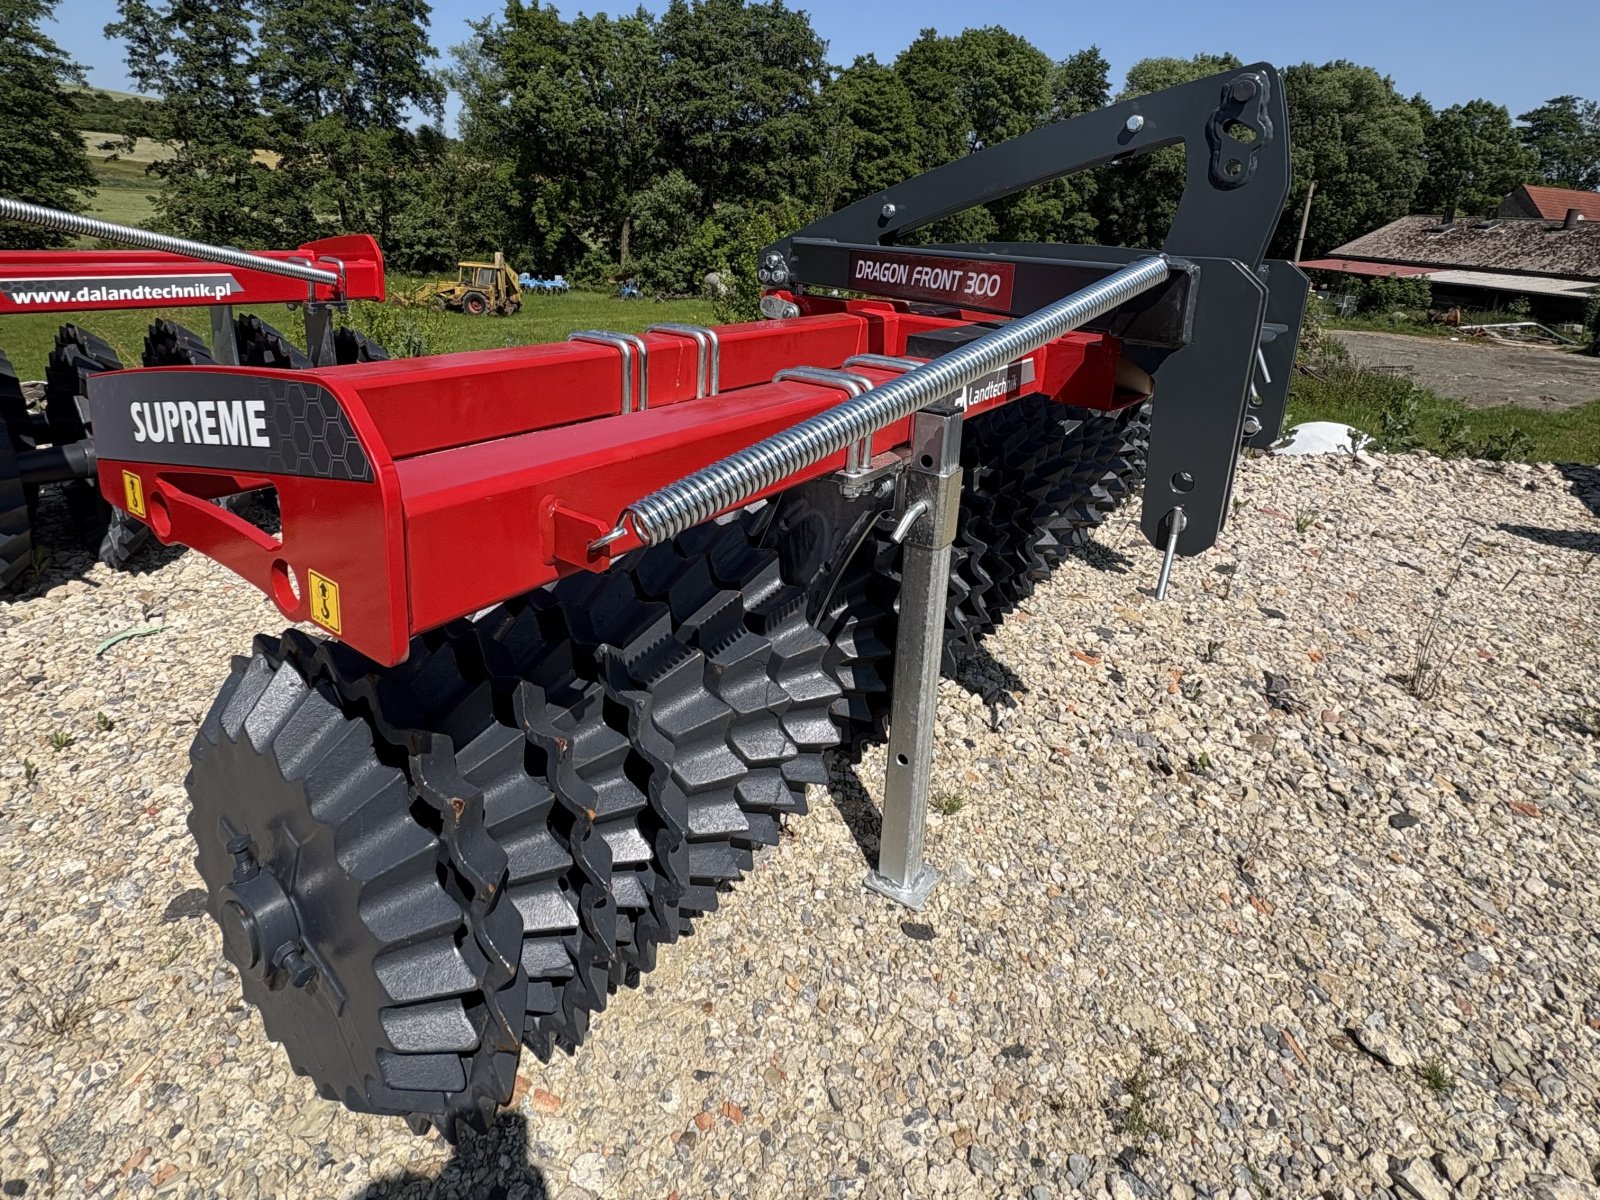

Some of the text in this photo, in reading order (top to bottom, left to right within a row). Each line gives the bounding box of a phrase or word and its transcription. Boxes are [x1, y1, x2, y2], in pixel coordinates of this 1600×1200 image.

[12, 283, 231, 304] www.dalandtechnik.pl
[855, 259, 1001, 297] DRAGON FRONT 300
[968, 373, 1018, 406] Landtechnik
[130, 400, 271, 448] SUPREME
